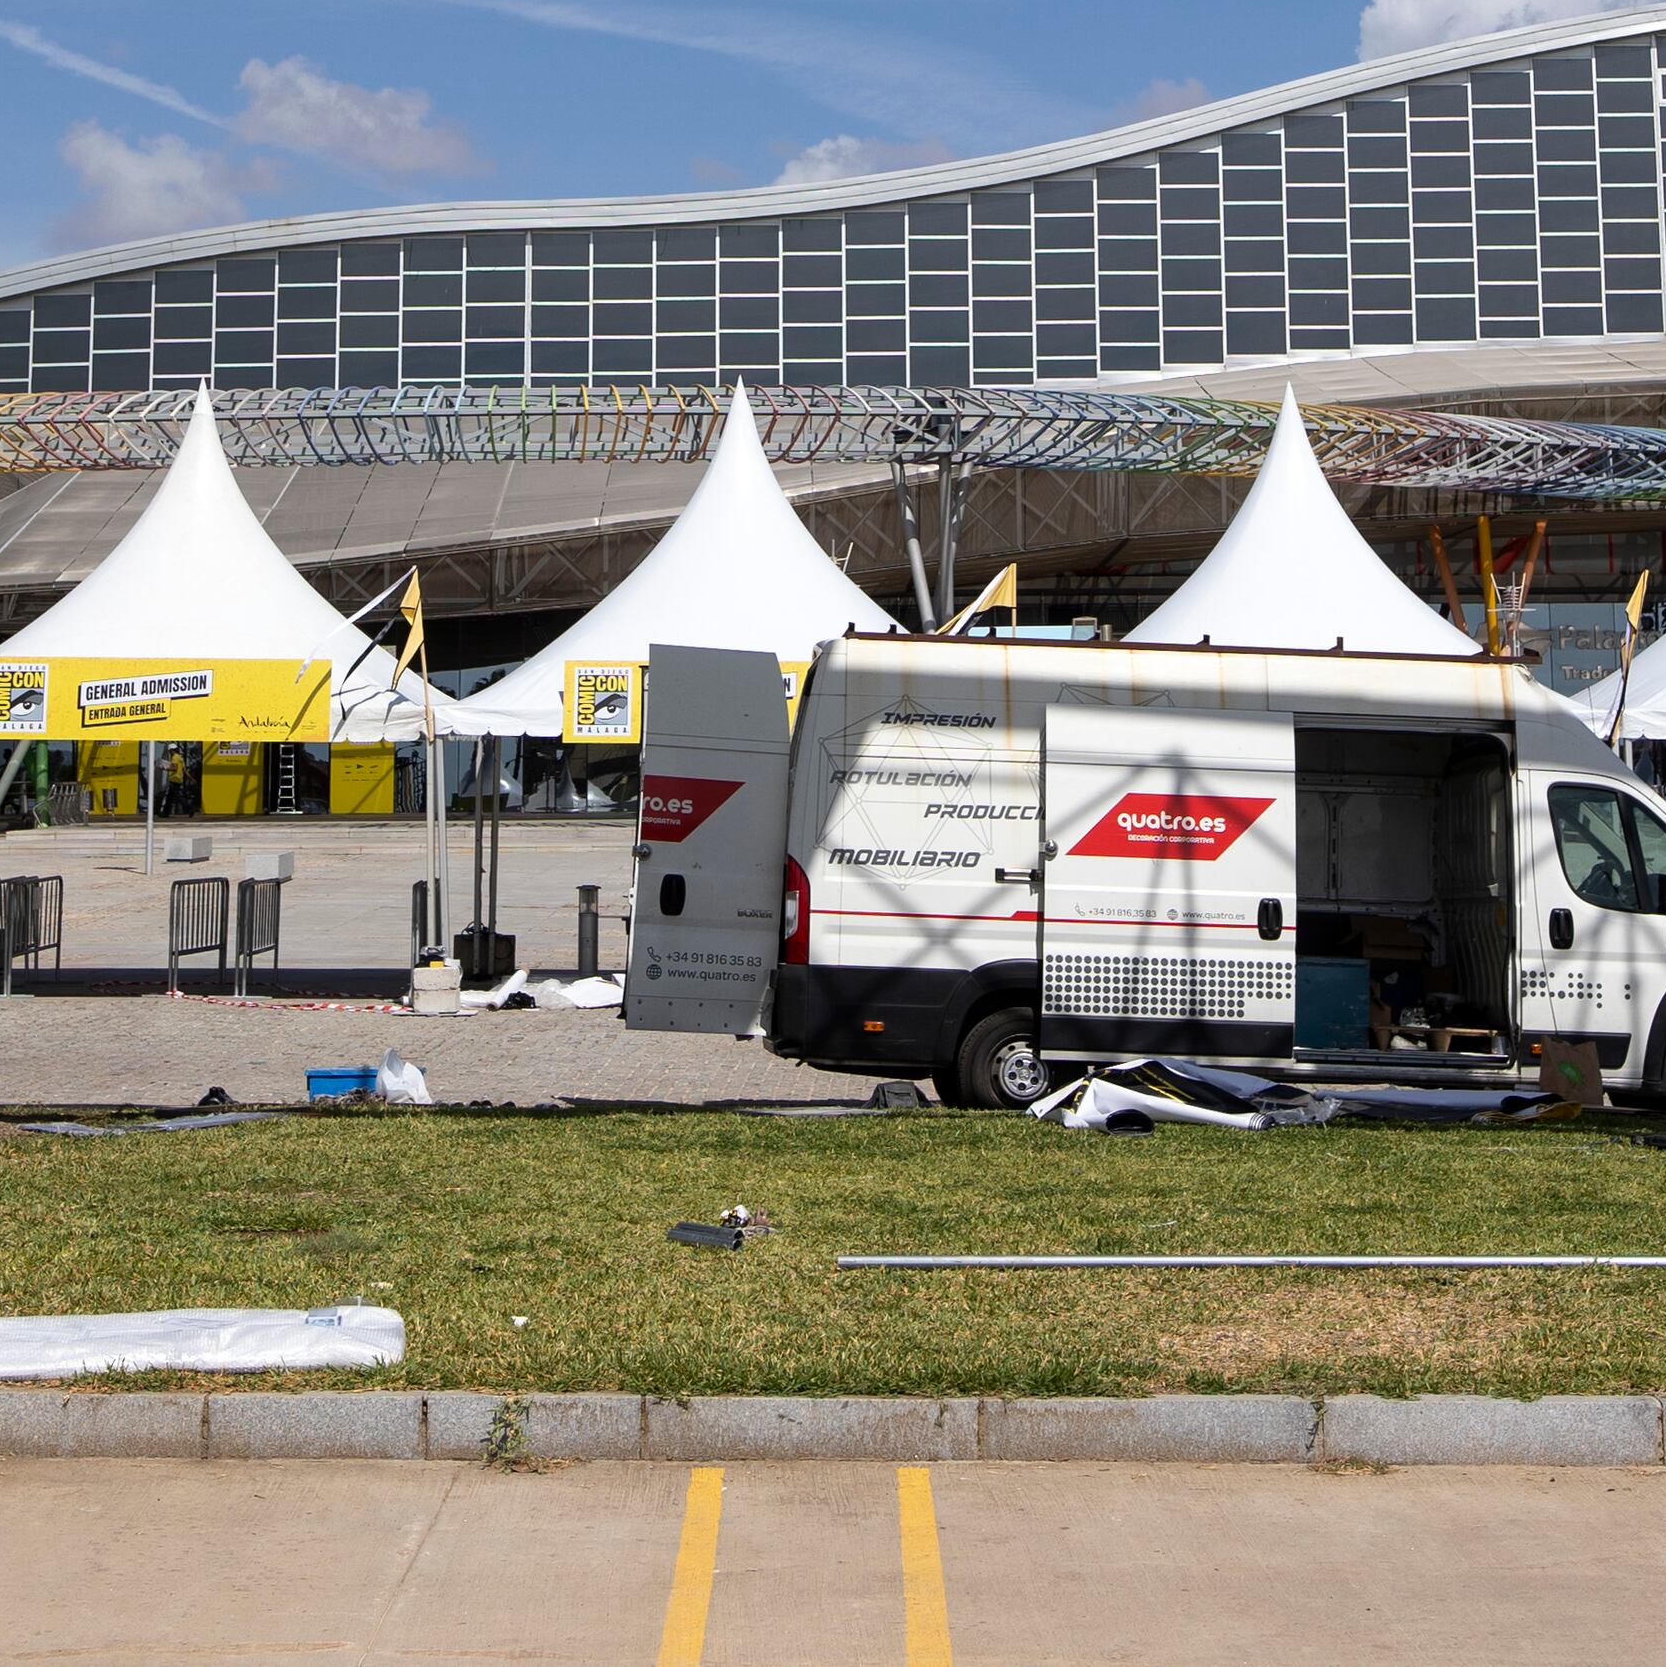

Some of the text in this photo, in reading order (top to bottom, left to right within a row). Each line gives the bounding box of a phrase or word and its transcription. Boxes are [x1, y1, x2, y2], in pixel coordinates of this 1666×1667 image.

[12, 672, 44, 688] CON
[85, 675, 207, 701] GENERAL ADMISSION
[595, 675, 628, 692] CON
[578, 676, 595, 725] COMIC
[88, 702, 166, 721] ENTRADA GENERAL
[881, 712, 997, 728] IMPRESIÓN
[829, 770, 973, 788] ROTULACIÓN
[642, 796, 693, 814] ro.es
[924, 803, 1045, 820] PRODUCCI
[642, 816, 681, 826] ORPORATIVA
[1117, 810, 1226, 833] quatro.es
[828, 848, 981, 868] MOBILIARIO
[1106, 908, 1116, 917] 91
[1117, 908, 1132, 918] 816
[1182, 910, 1246, 921] www.quatro.es
[666, 951, 762, 968] +34 91 816 35 83
[667, 967, 757, 983] www.quatro.es
